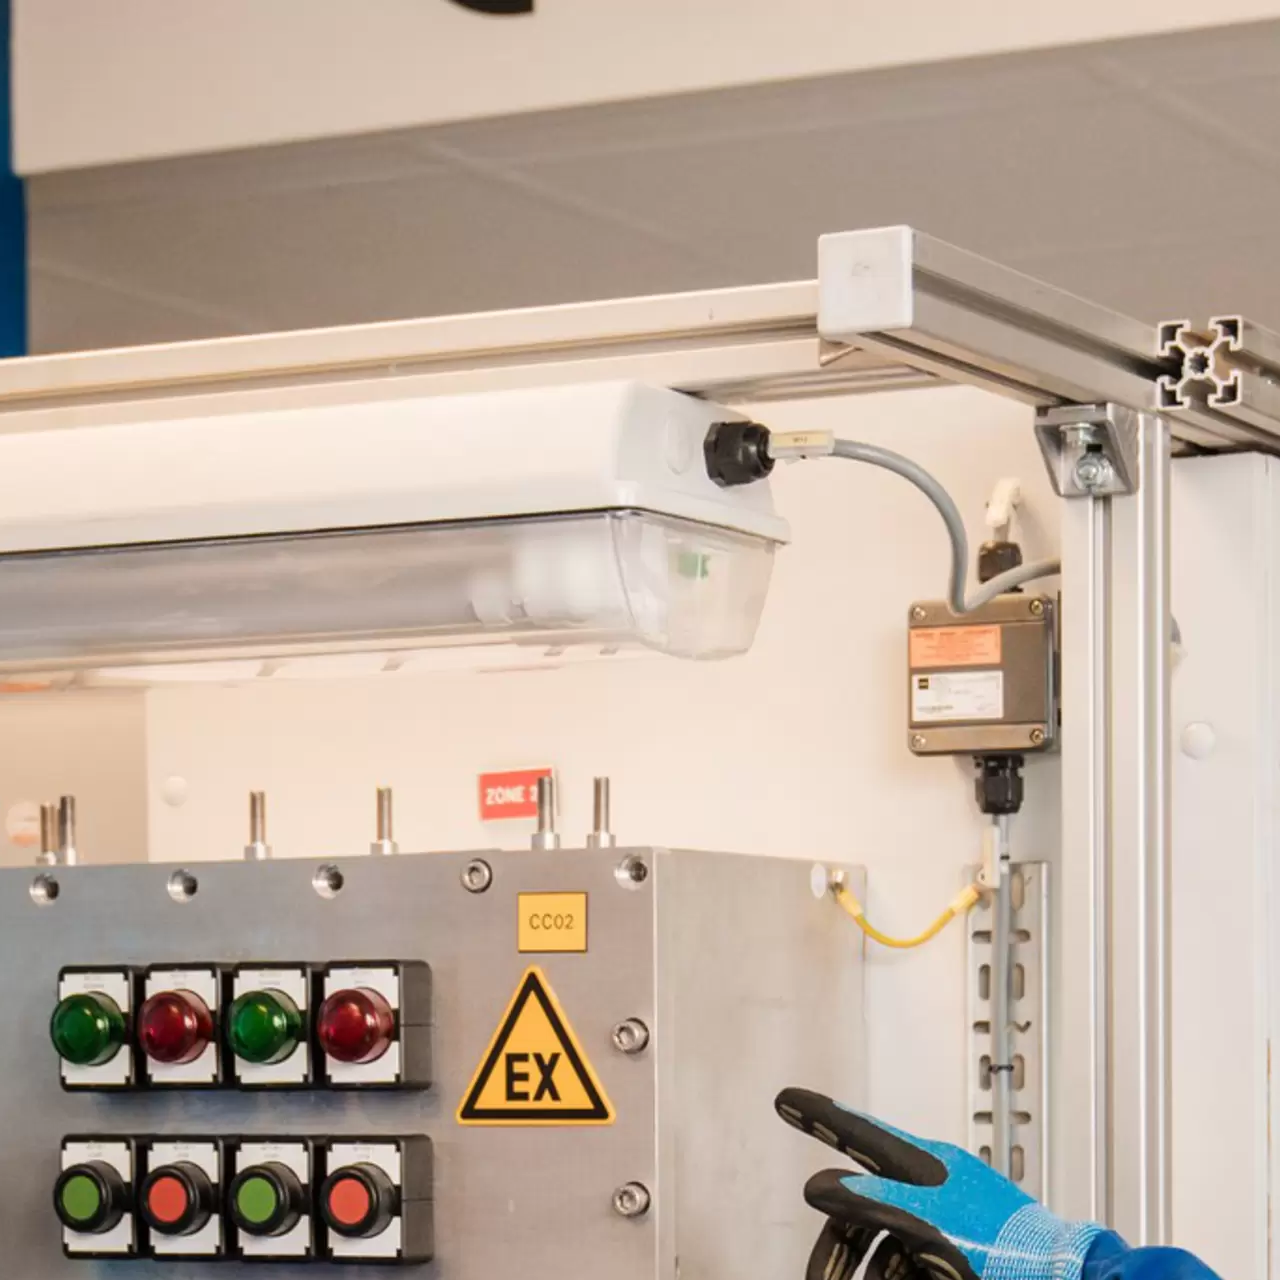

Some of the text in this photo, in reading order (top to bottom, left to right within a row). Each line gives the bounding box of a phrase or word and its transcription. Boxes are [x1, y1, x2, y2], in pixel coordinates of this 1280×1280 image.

[485, 785, 525, 805] ZONE
[528, 912, 574, 931] CC02
[505, 1052, 562, 1102] EX
